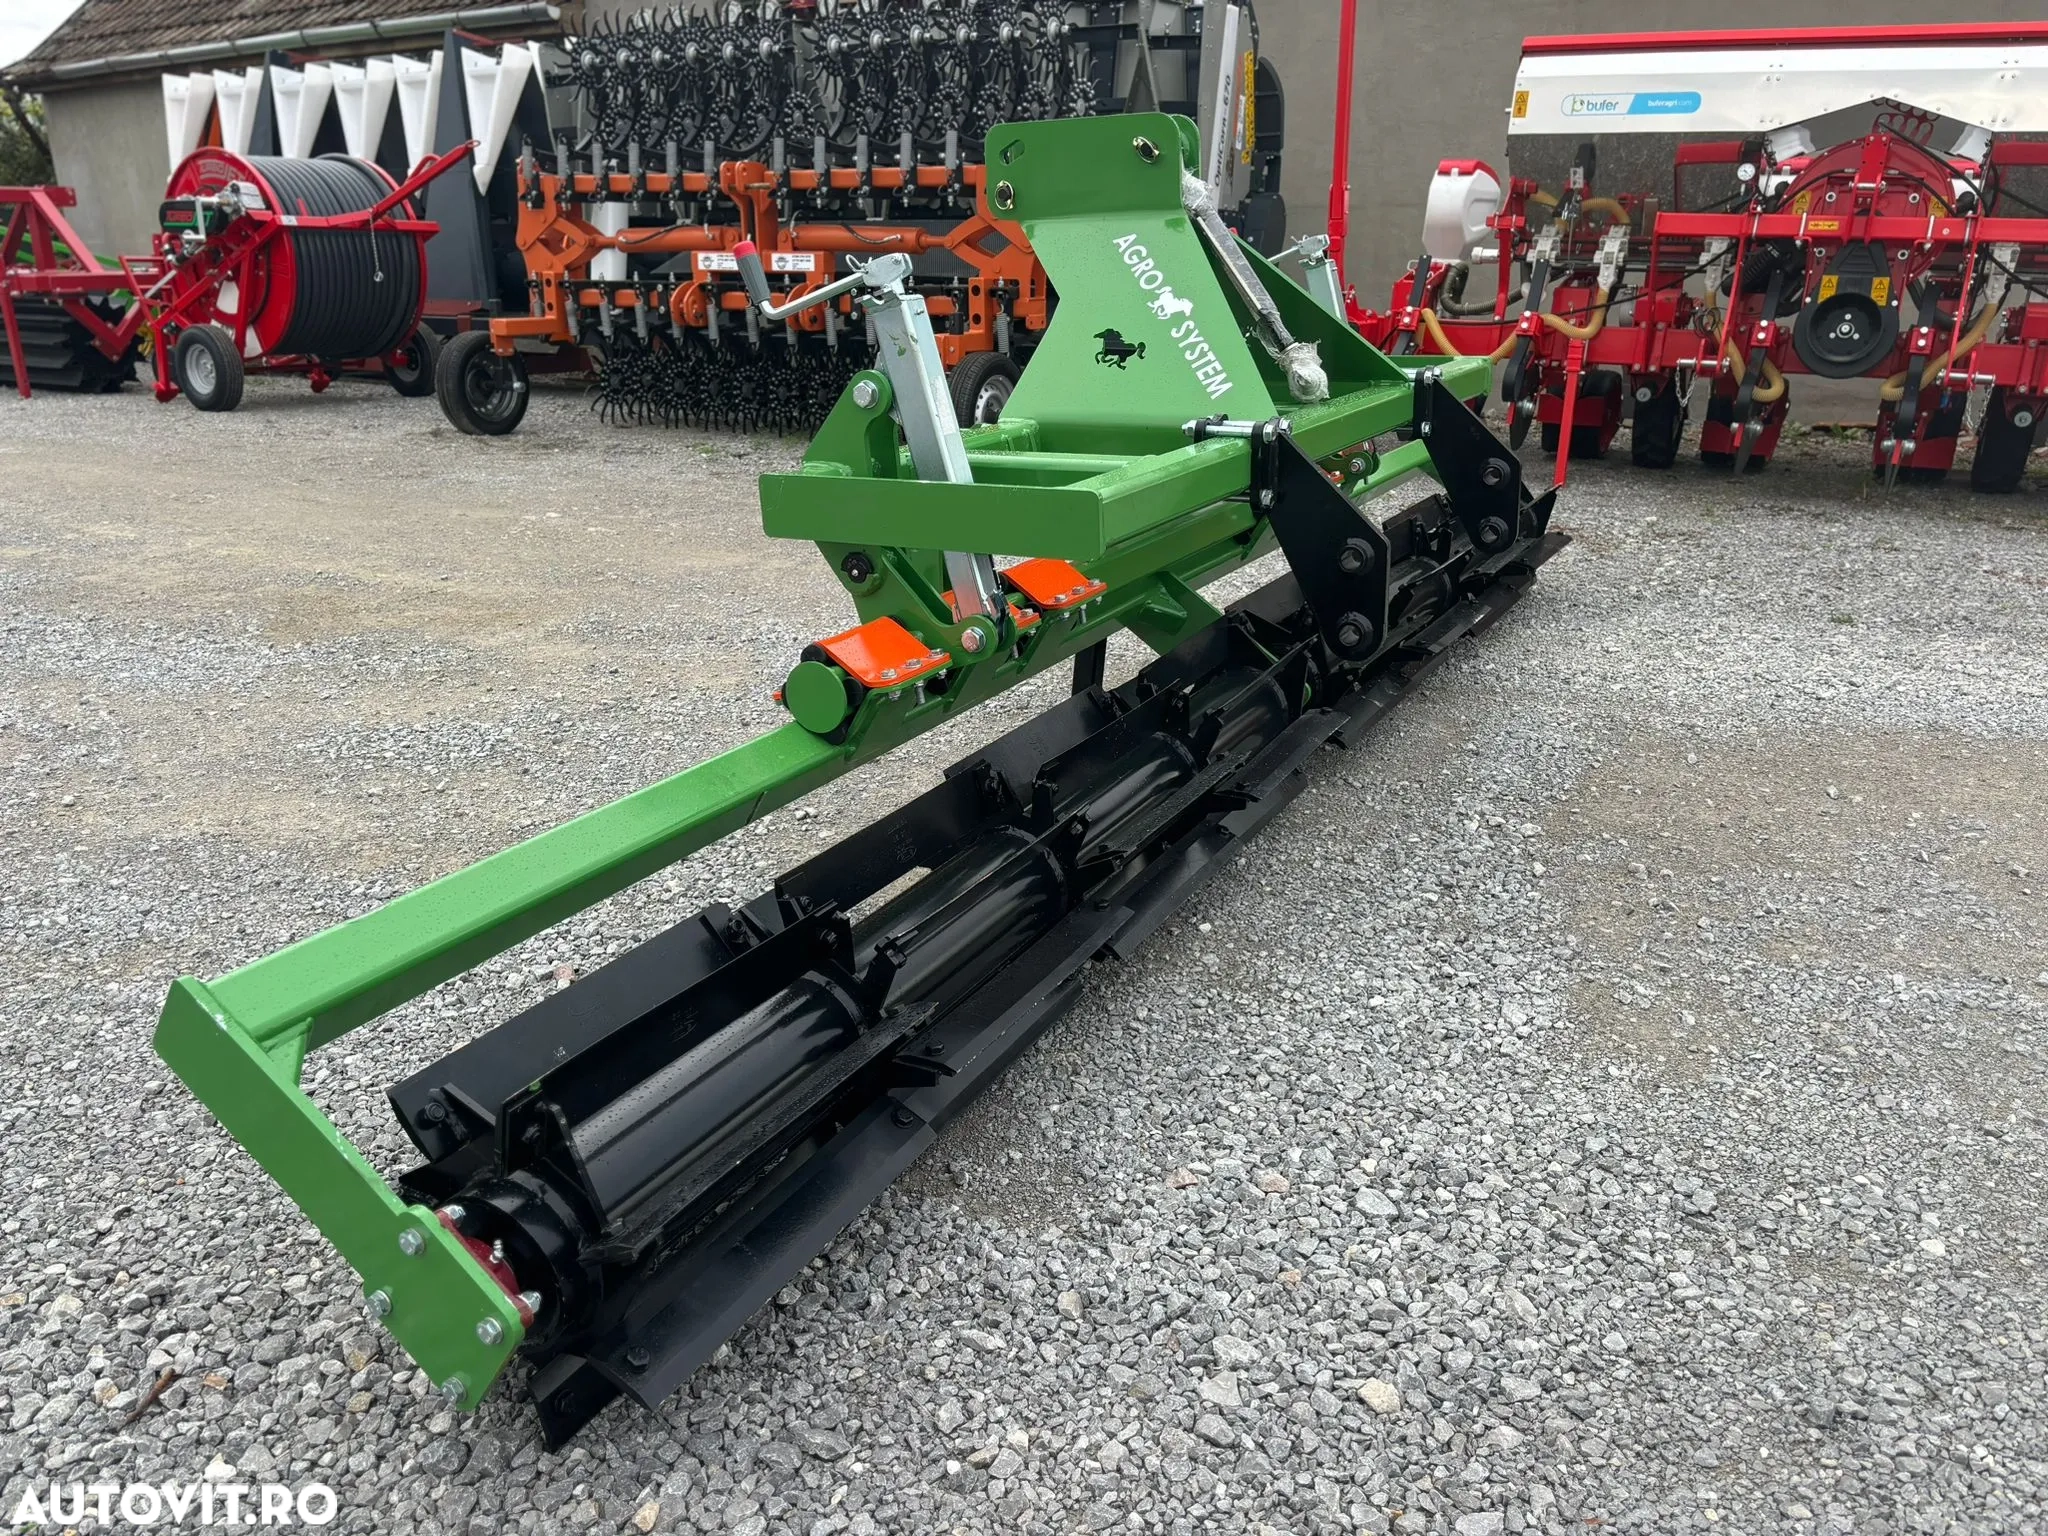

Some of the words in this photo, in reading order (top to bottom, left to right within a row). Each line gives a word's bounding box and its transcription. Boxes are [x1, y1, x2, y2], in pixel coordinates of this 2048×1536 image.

[1214, 117, 1228, 187] OptiCorn
[1223, 75, 1232, 106] 670
[1586, 99, 1619, 112] bufer
[1112, 233, 1164, 290] AGRO
[1170, 320, 1233, 400] SYSTEM
